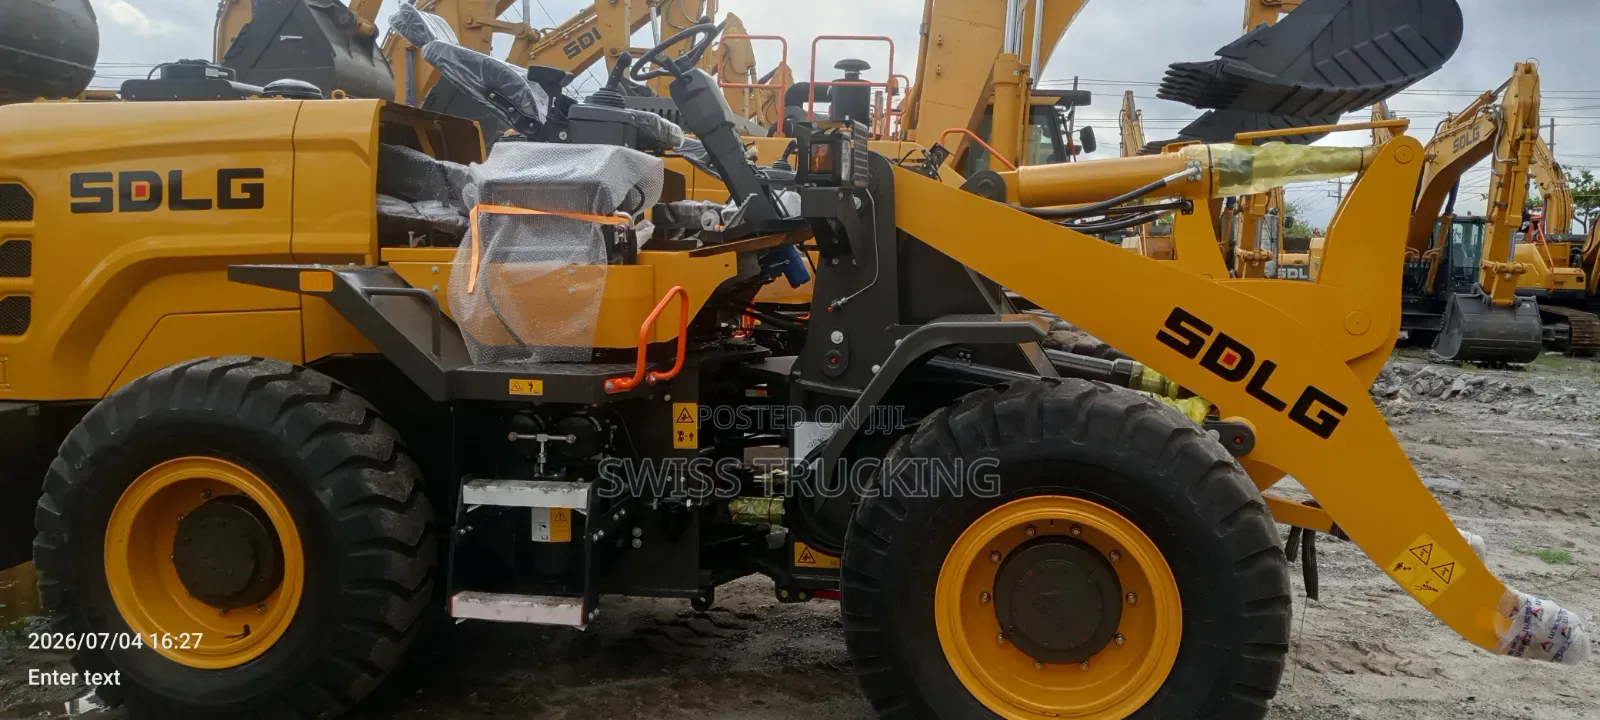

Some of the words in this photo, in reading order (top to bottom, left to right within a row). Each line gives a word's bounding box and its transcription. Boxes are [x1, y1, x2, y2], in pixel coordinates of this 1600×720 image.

[1452, 124, 1480, 154] SDLG
[70, 168, 264, 214] SDLG
[1277, 267, 1308, 279] SDL
[1156, 306, 1348, 439] SDLG
